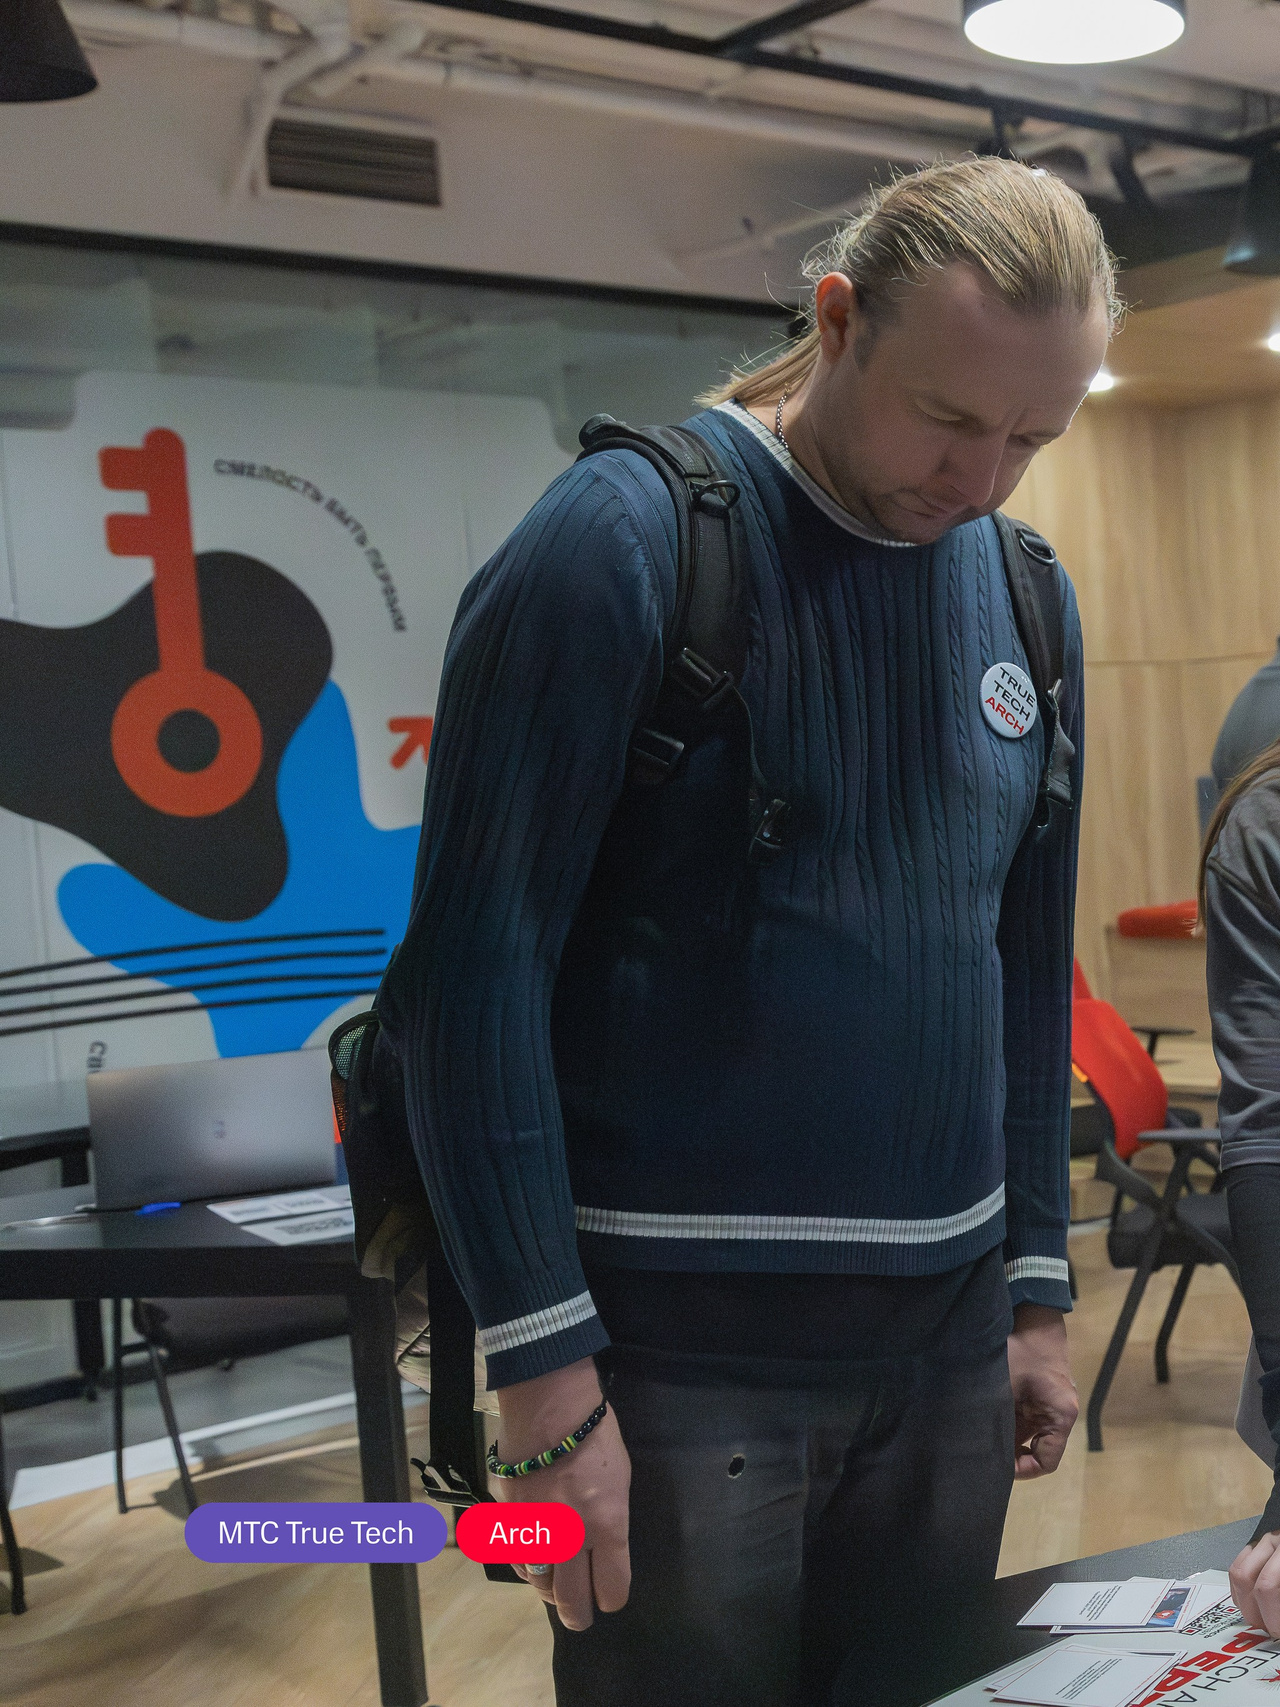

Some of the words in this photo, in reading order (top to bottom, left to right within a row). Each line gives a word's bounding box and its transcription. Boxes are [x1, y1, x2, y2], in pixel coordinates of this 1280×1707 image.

[993, 680, 1031, 722] TECH
[999, 666, 1036, 708] TRUE
[985, 696, 1025, 735] ARCH
